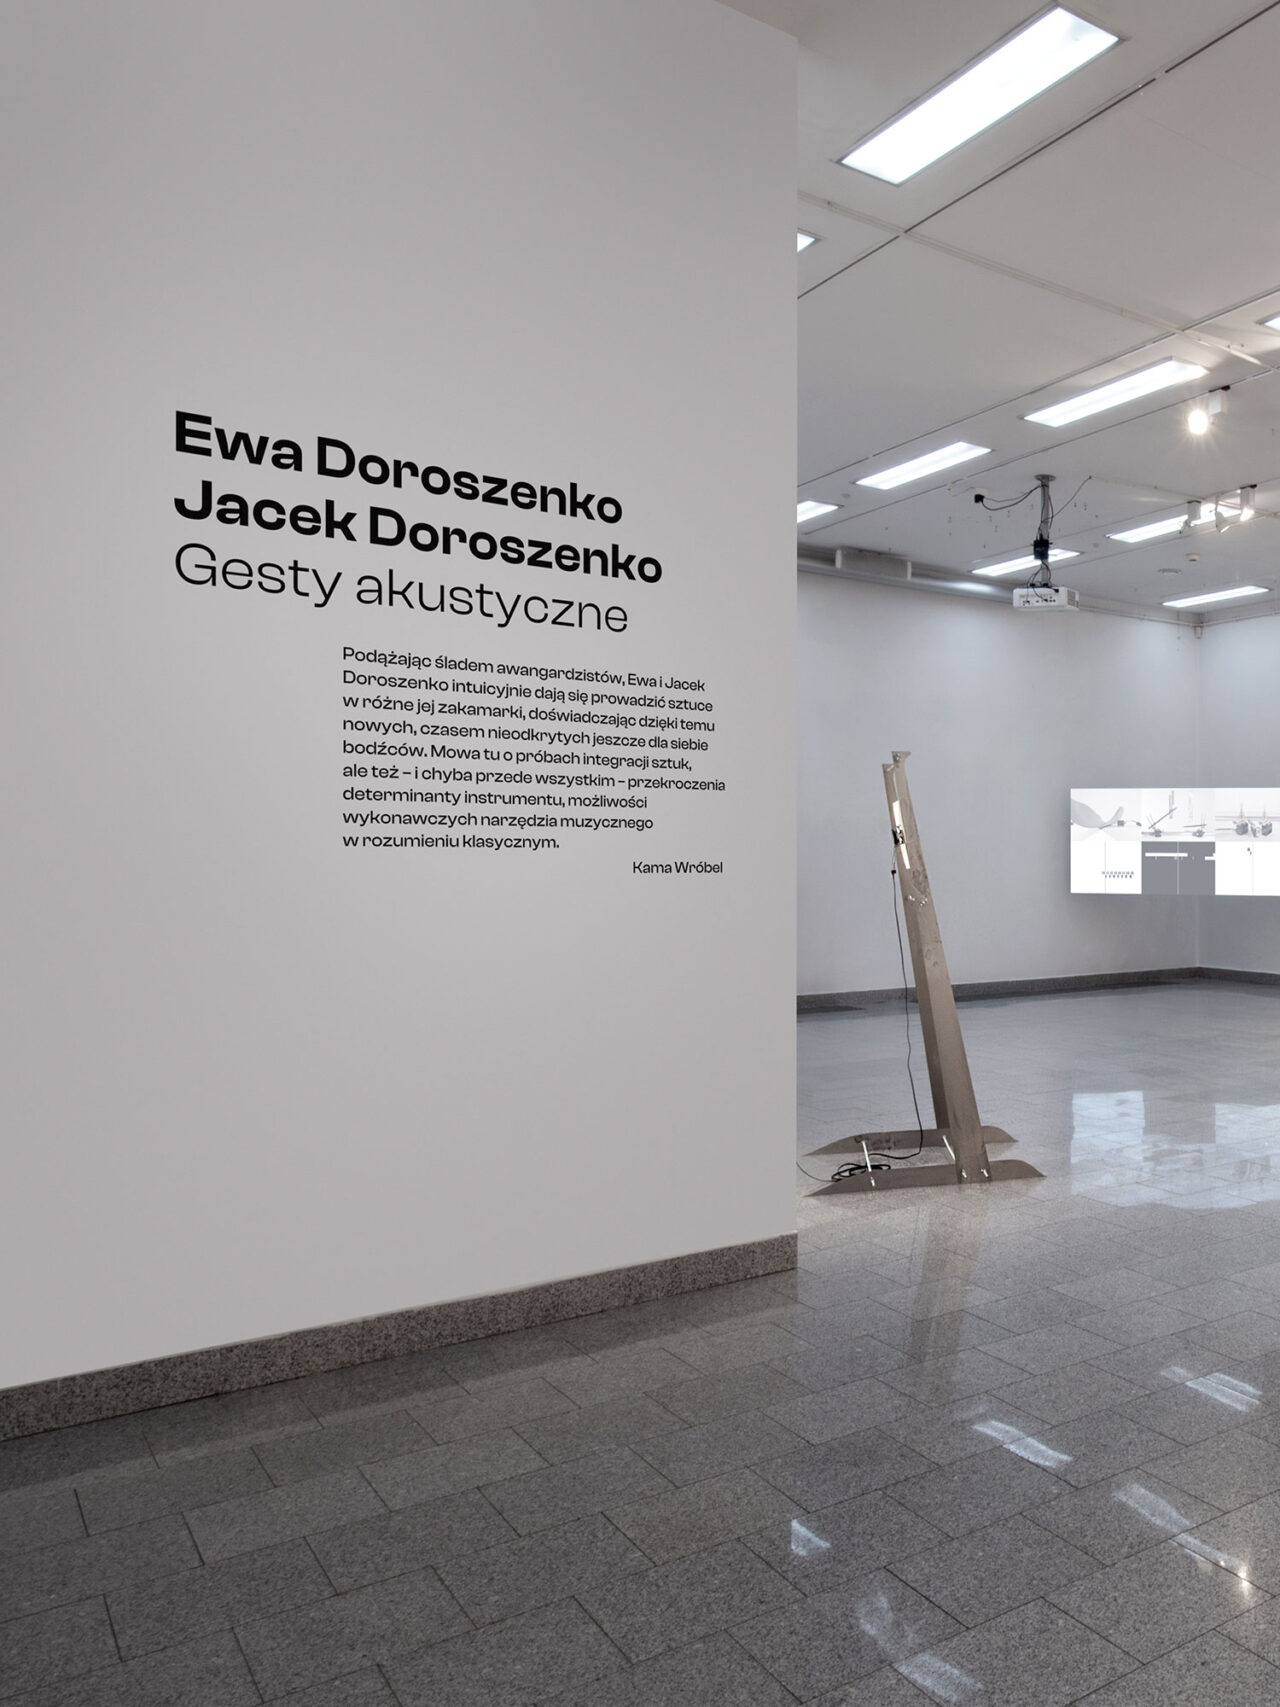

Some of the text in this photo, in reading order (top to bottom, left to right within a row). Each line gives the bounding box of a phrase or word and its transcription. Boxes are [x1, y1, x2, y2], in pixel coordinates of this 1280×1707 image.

[175, 410, 623, 524] Ewa Doroszenko
[174, 480, 662, 583] Jacek Doroszenko
[175, 543, 628, 633] Gesty akustyczne
[343, 646, 705, 692] Podążając śladem awangardzistów, Ewa i Jacek
[343, 670, 713, 712] Doroszenko intuicyjnie dają się prowadzić sztuce
[343, 695, 715, 732] w różne jej zakamarki, doświadczając dzięki temu
[343, 720, 708, 751] nowych, czasem nieodkrytych jeszcze dla siebie
[343, 740, 692, 772] bodźców. Mowa tu o próbach integracji sztuk,
[343, 763, 368, 778] ale
[371, 765, 399, 779] też
[414, 766, 419, 779] i
[421, 767, 472, 784] chyba
[476, 771, 532, 784] przede
[535, 774, 615, 788] wszystkim
[628, 777, 725, 791] przekroczenia
[343, 787, 647, 808] determinanty instrumentu, możliwości
[342, 810, 653, 832] wykonawczych narzędzia muzycznego
[342, 834, 559, 851] w rozumieniu klasycznym.
[633, 861, 723, 874] Kama Wróbel
